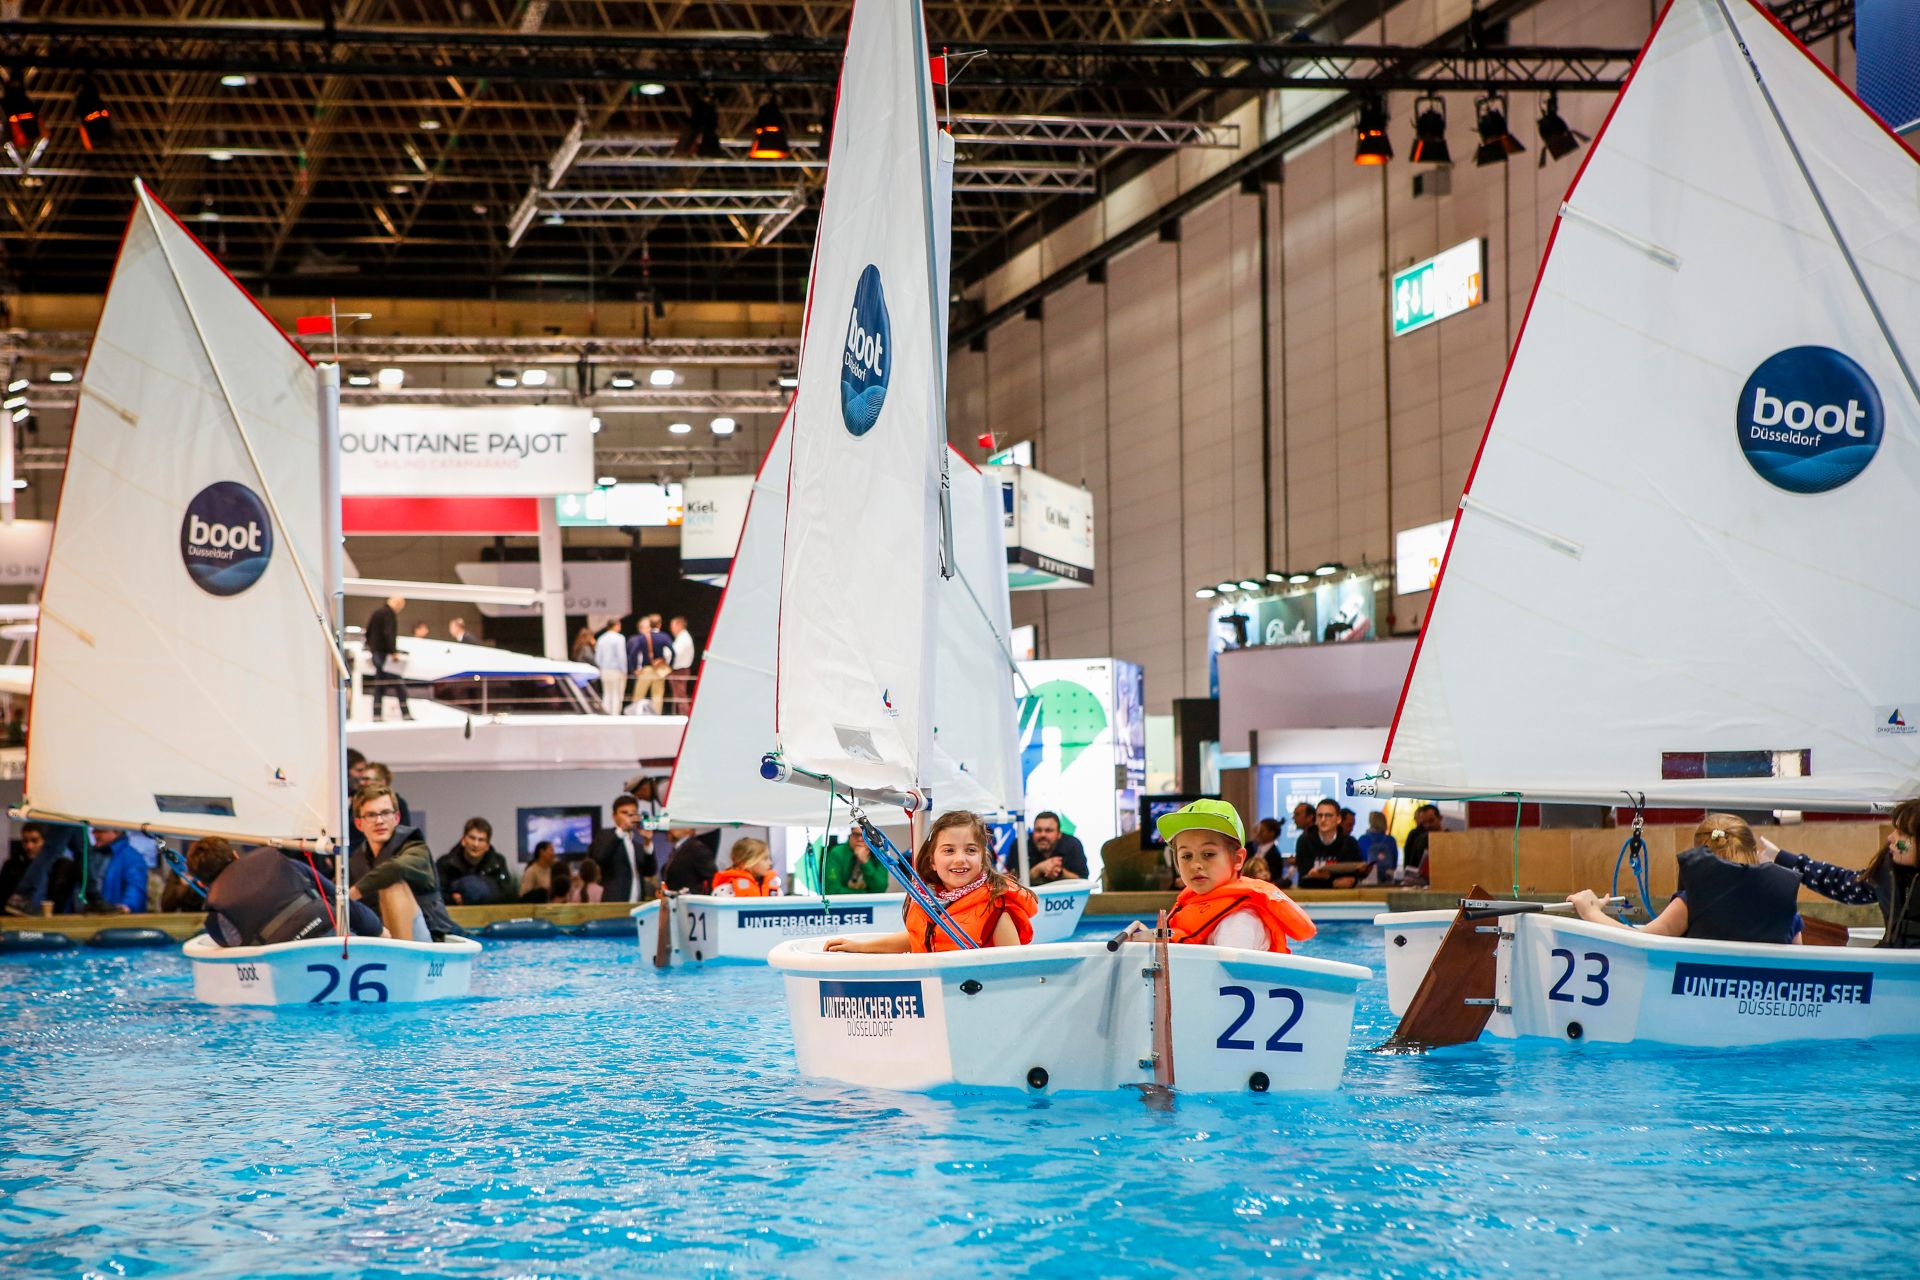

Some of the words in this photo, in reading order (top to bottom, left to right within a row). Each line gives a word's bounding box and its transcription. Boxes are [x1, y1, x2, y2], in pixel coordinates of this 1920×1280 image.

[848, 308, 883, 377] boot
[1753, 387, 1866, 438] boot
[339, 432, 479, 454] OUNTAINE
[488, 432, 567, 458] PAJOT
[1750, 426, 1822, 447] Düsseldorf
[188, 514, 262, 552] boot
[187, 545, 234, 560] Düsseldorf
[1359, 785, 1375, 796] 23
[1045, 896, 1075, 912] boot
[688, 912, 707, 942] 21
[744, 914, 841, 929] UNTERBACHER
[844, 913, 868, 926] SEE
[305, 963, 389, 1004] 26
[1549, 948, 1610, 1006] 23
[1683, 976, 1826, 1004] UNTERBACHER
[1829, 984, 1864, 1004] SEE
[823, 996, 893, 1019] UNTERBACHER
[895, 995, 918, 1018] SEE
[1216, 985, 1305, 1052] 22
[1738, 999, 1824, 1018] DÜSSELDORF
[847, 1019, 894, 1037] DÜSSELDORF
